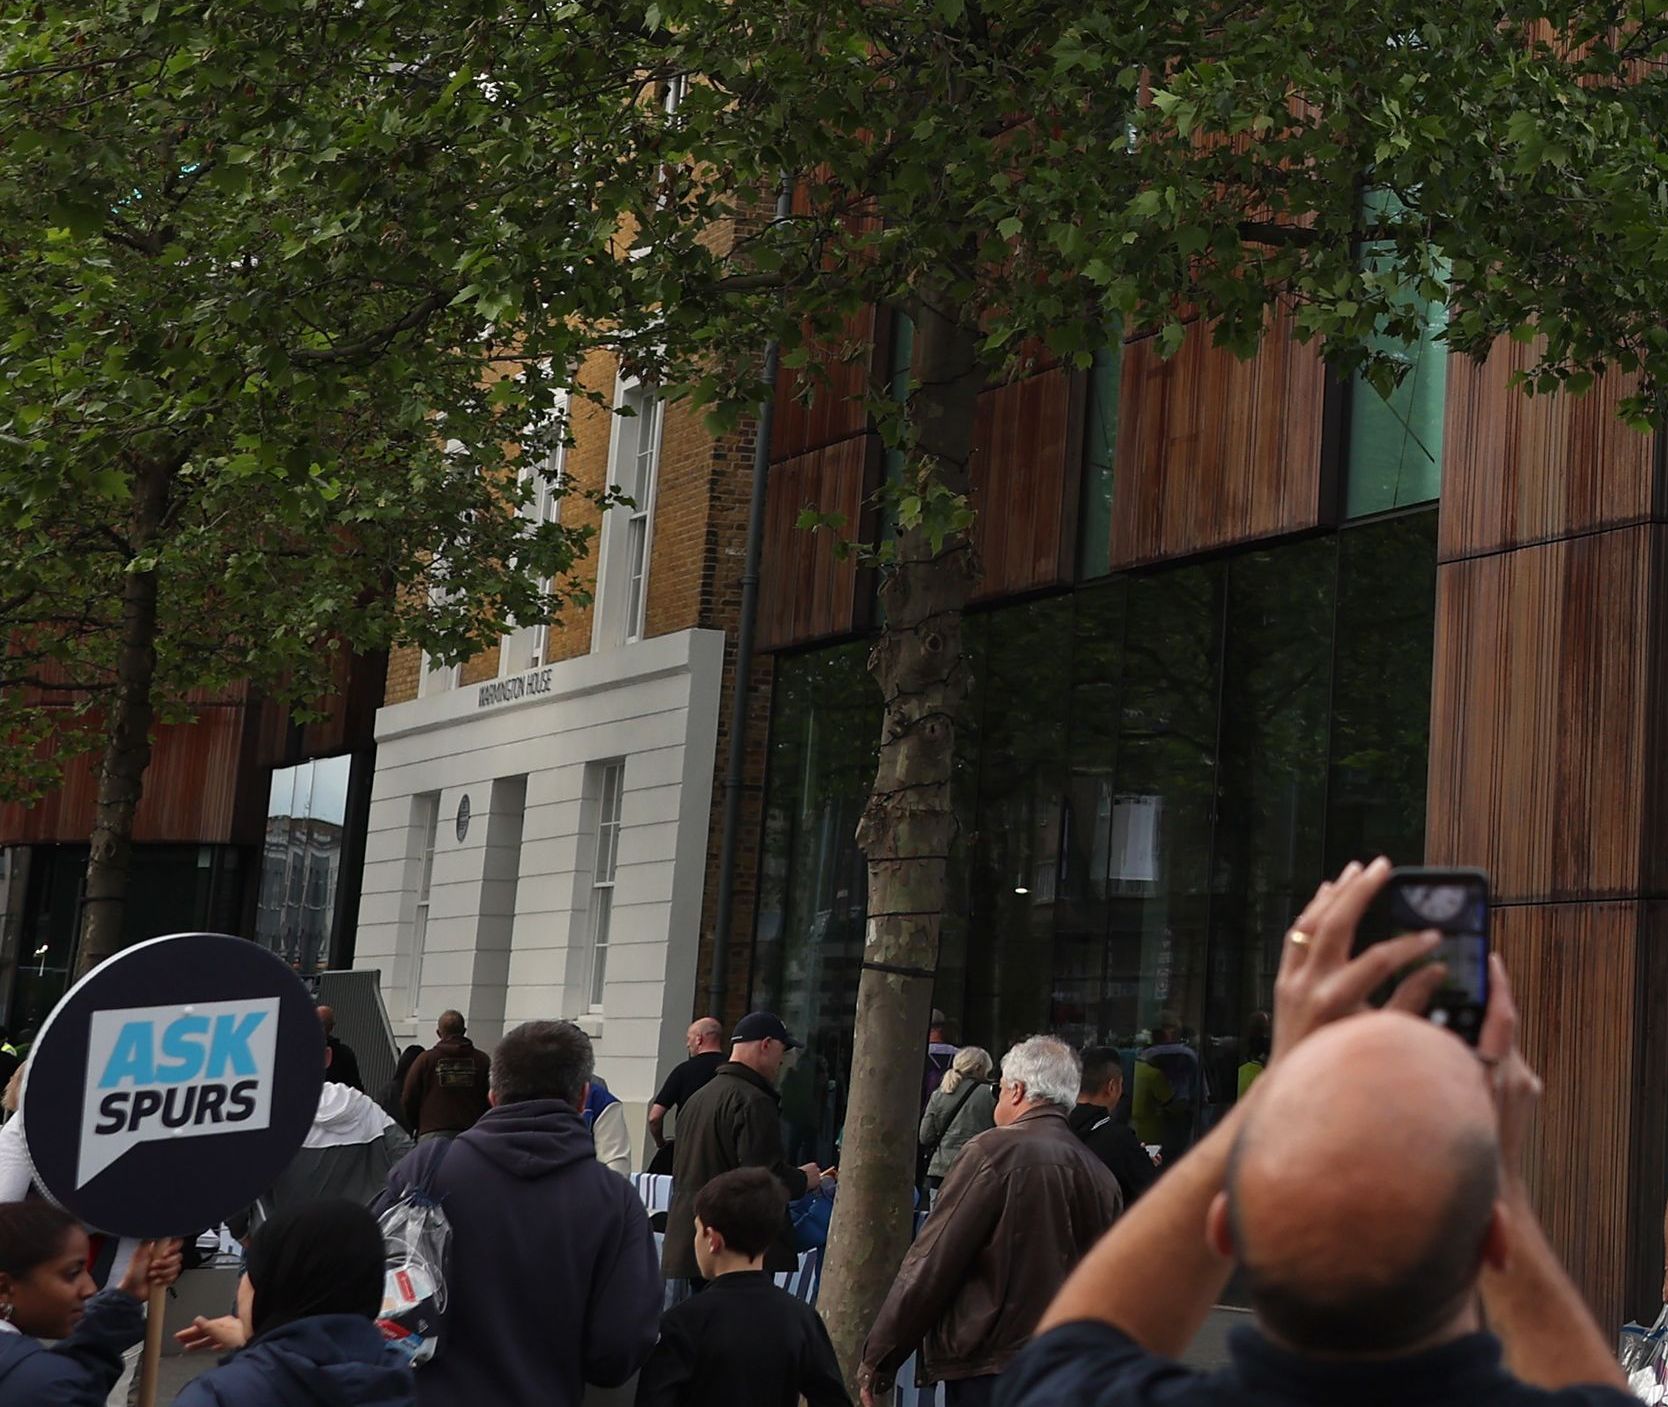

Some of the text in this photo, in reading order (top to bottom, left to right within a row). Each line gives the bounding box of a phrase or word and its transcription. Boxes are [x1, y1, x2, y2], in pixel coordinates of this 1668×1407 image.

[526, 669, 552, 696] HOUSE
[98, 1012, 268, 1089] ASK
[95, 1080, 259, 1135] SPURS
